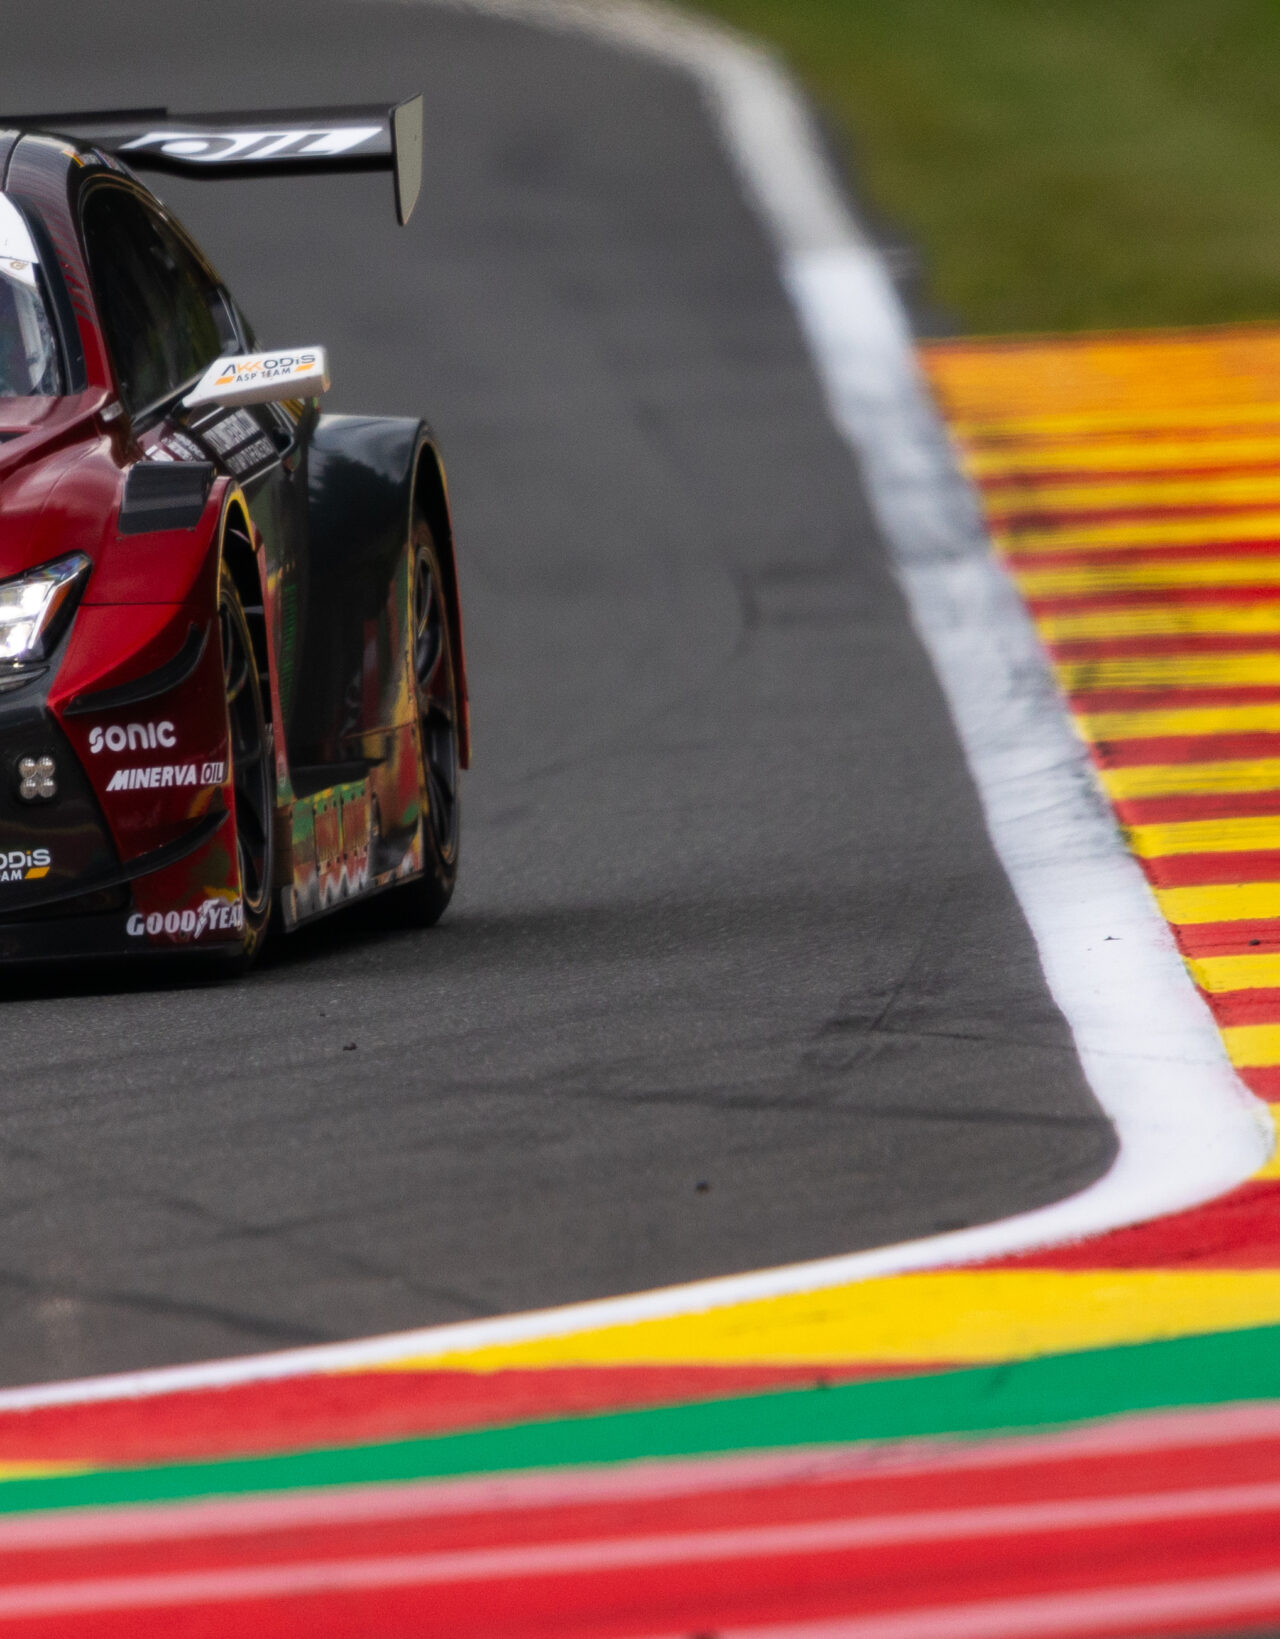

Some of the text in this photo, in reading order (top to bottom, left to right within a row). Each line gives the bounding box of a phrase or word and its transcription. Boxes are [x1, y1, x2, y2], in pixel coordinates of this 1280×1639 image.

[133, 132, 335, 160] OIL
[235, 367, 291, 382] ASP TEAM
[106, 762, 224, 792] MINERVA OIL
[126, 899, 243, 939] GOODYEA
